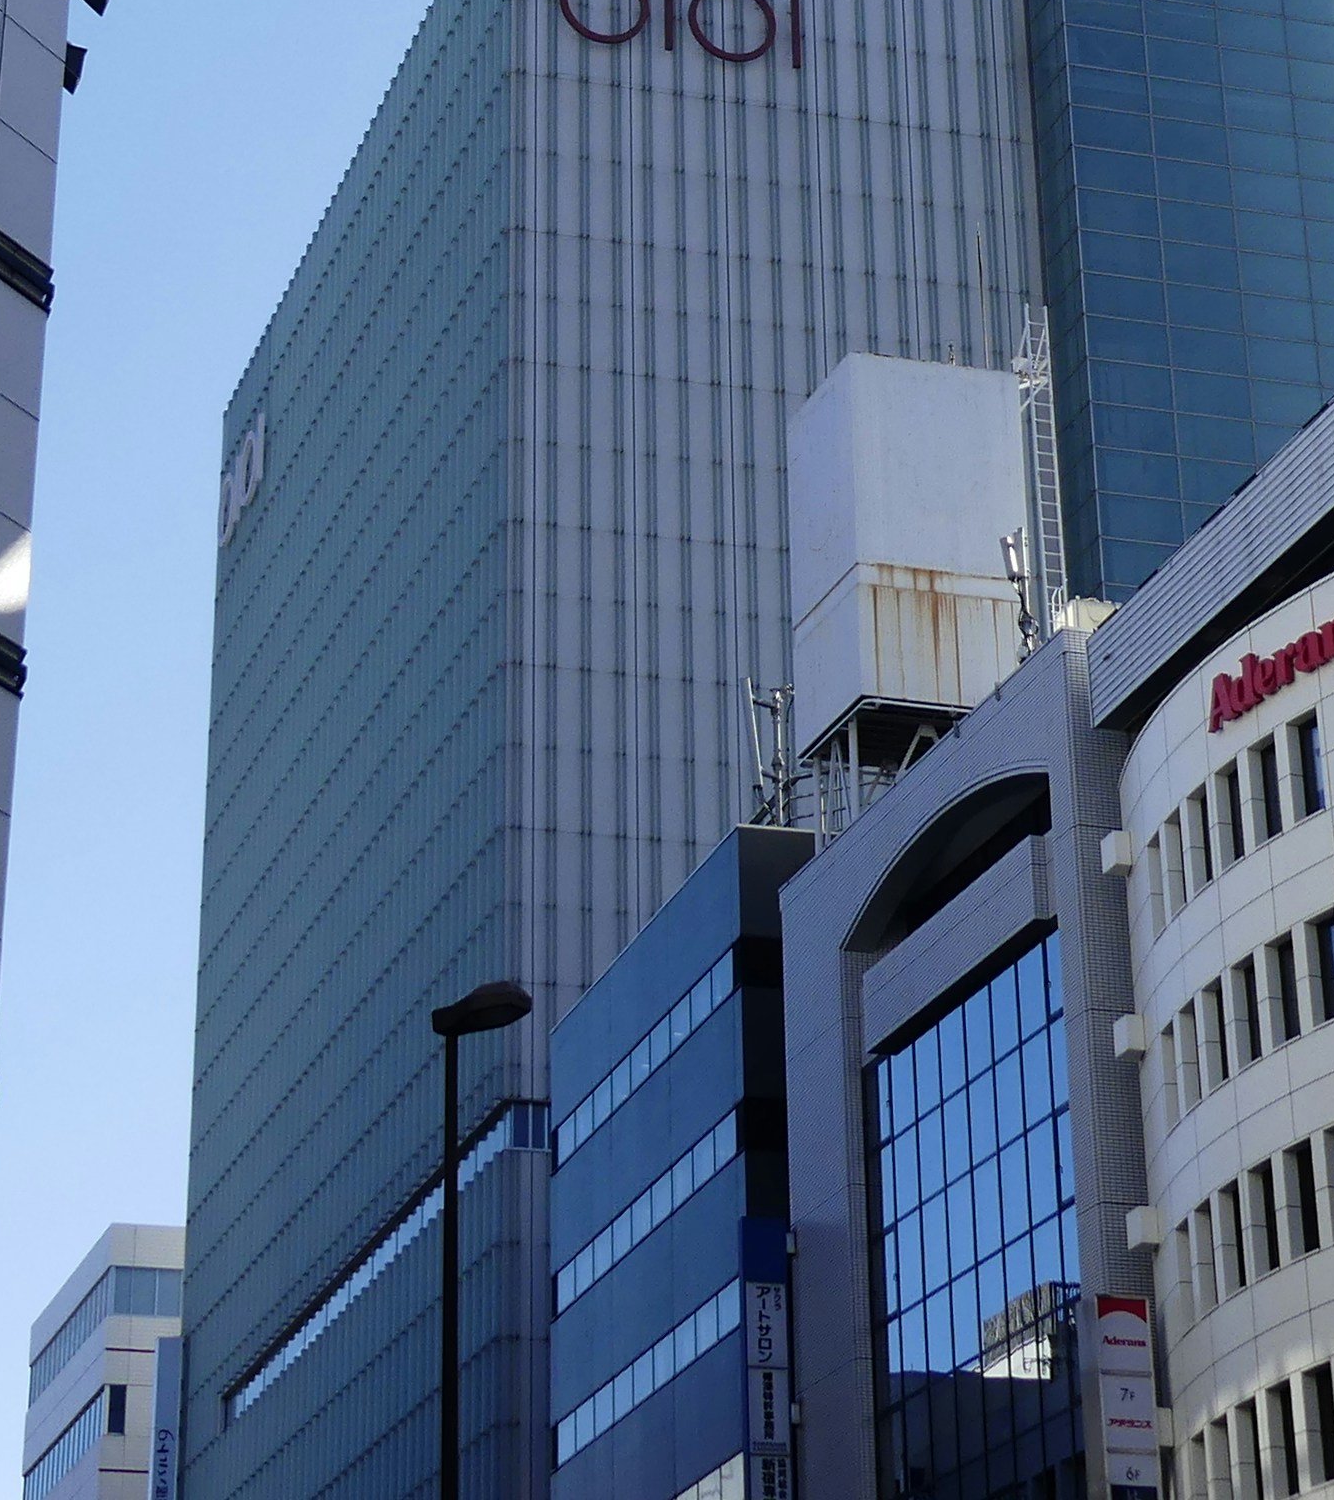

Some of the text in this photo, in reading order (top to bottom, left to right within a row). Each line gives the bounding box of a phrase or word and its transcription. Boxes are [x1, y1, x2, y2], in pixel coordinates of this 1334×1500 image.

[755, 1285, 773, 1364] アートサロン
[1102, 1335, 1147, 1347] Aderans
[1120, 1387, 1136, 1401] 7F
